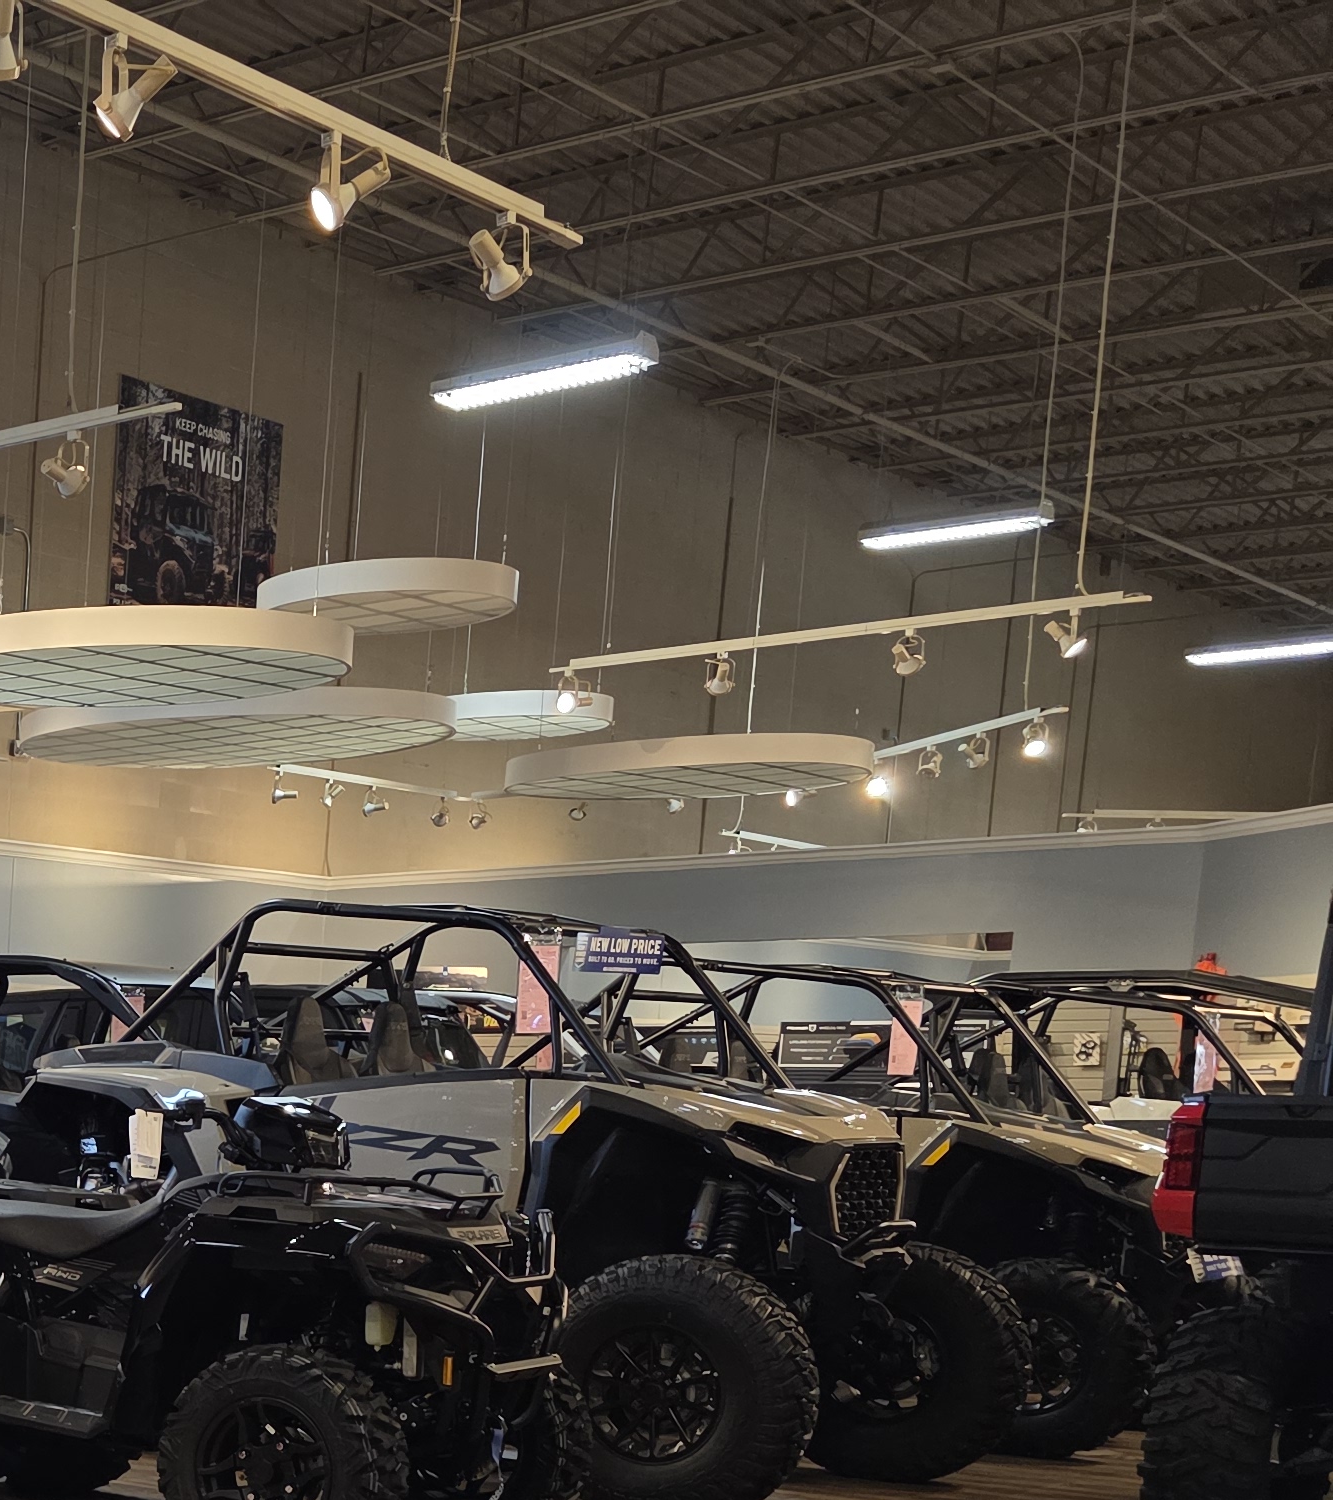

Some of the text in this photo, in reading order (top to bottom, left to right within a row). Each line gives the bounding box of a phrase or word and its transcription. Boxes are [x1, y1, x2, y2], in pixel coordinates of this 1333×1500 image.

[175, 416, 232, 445] KEEP CHASING
[160, 433, 243, 482] THE WILD
[589, 936, 610, 953] NEW
[610, 937, 631, 954] LOW
[630, 938, 662, 955] PRICE
